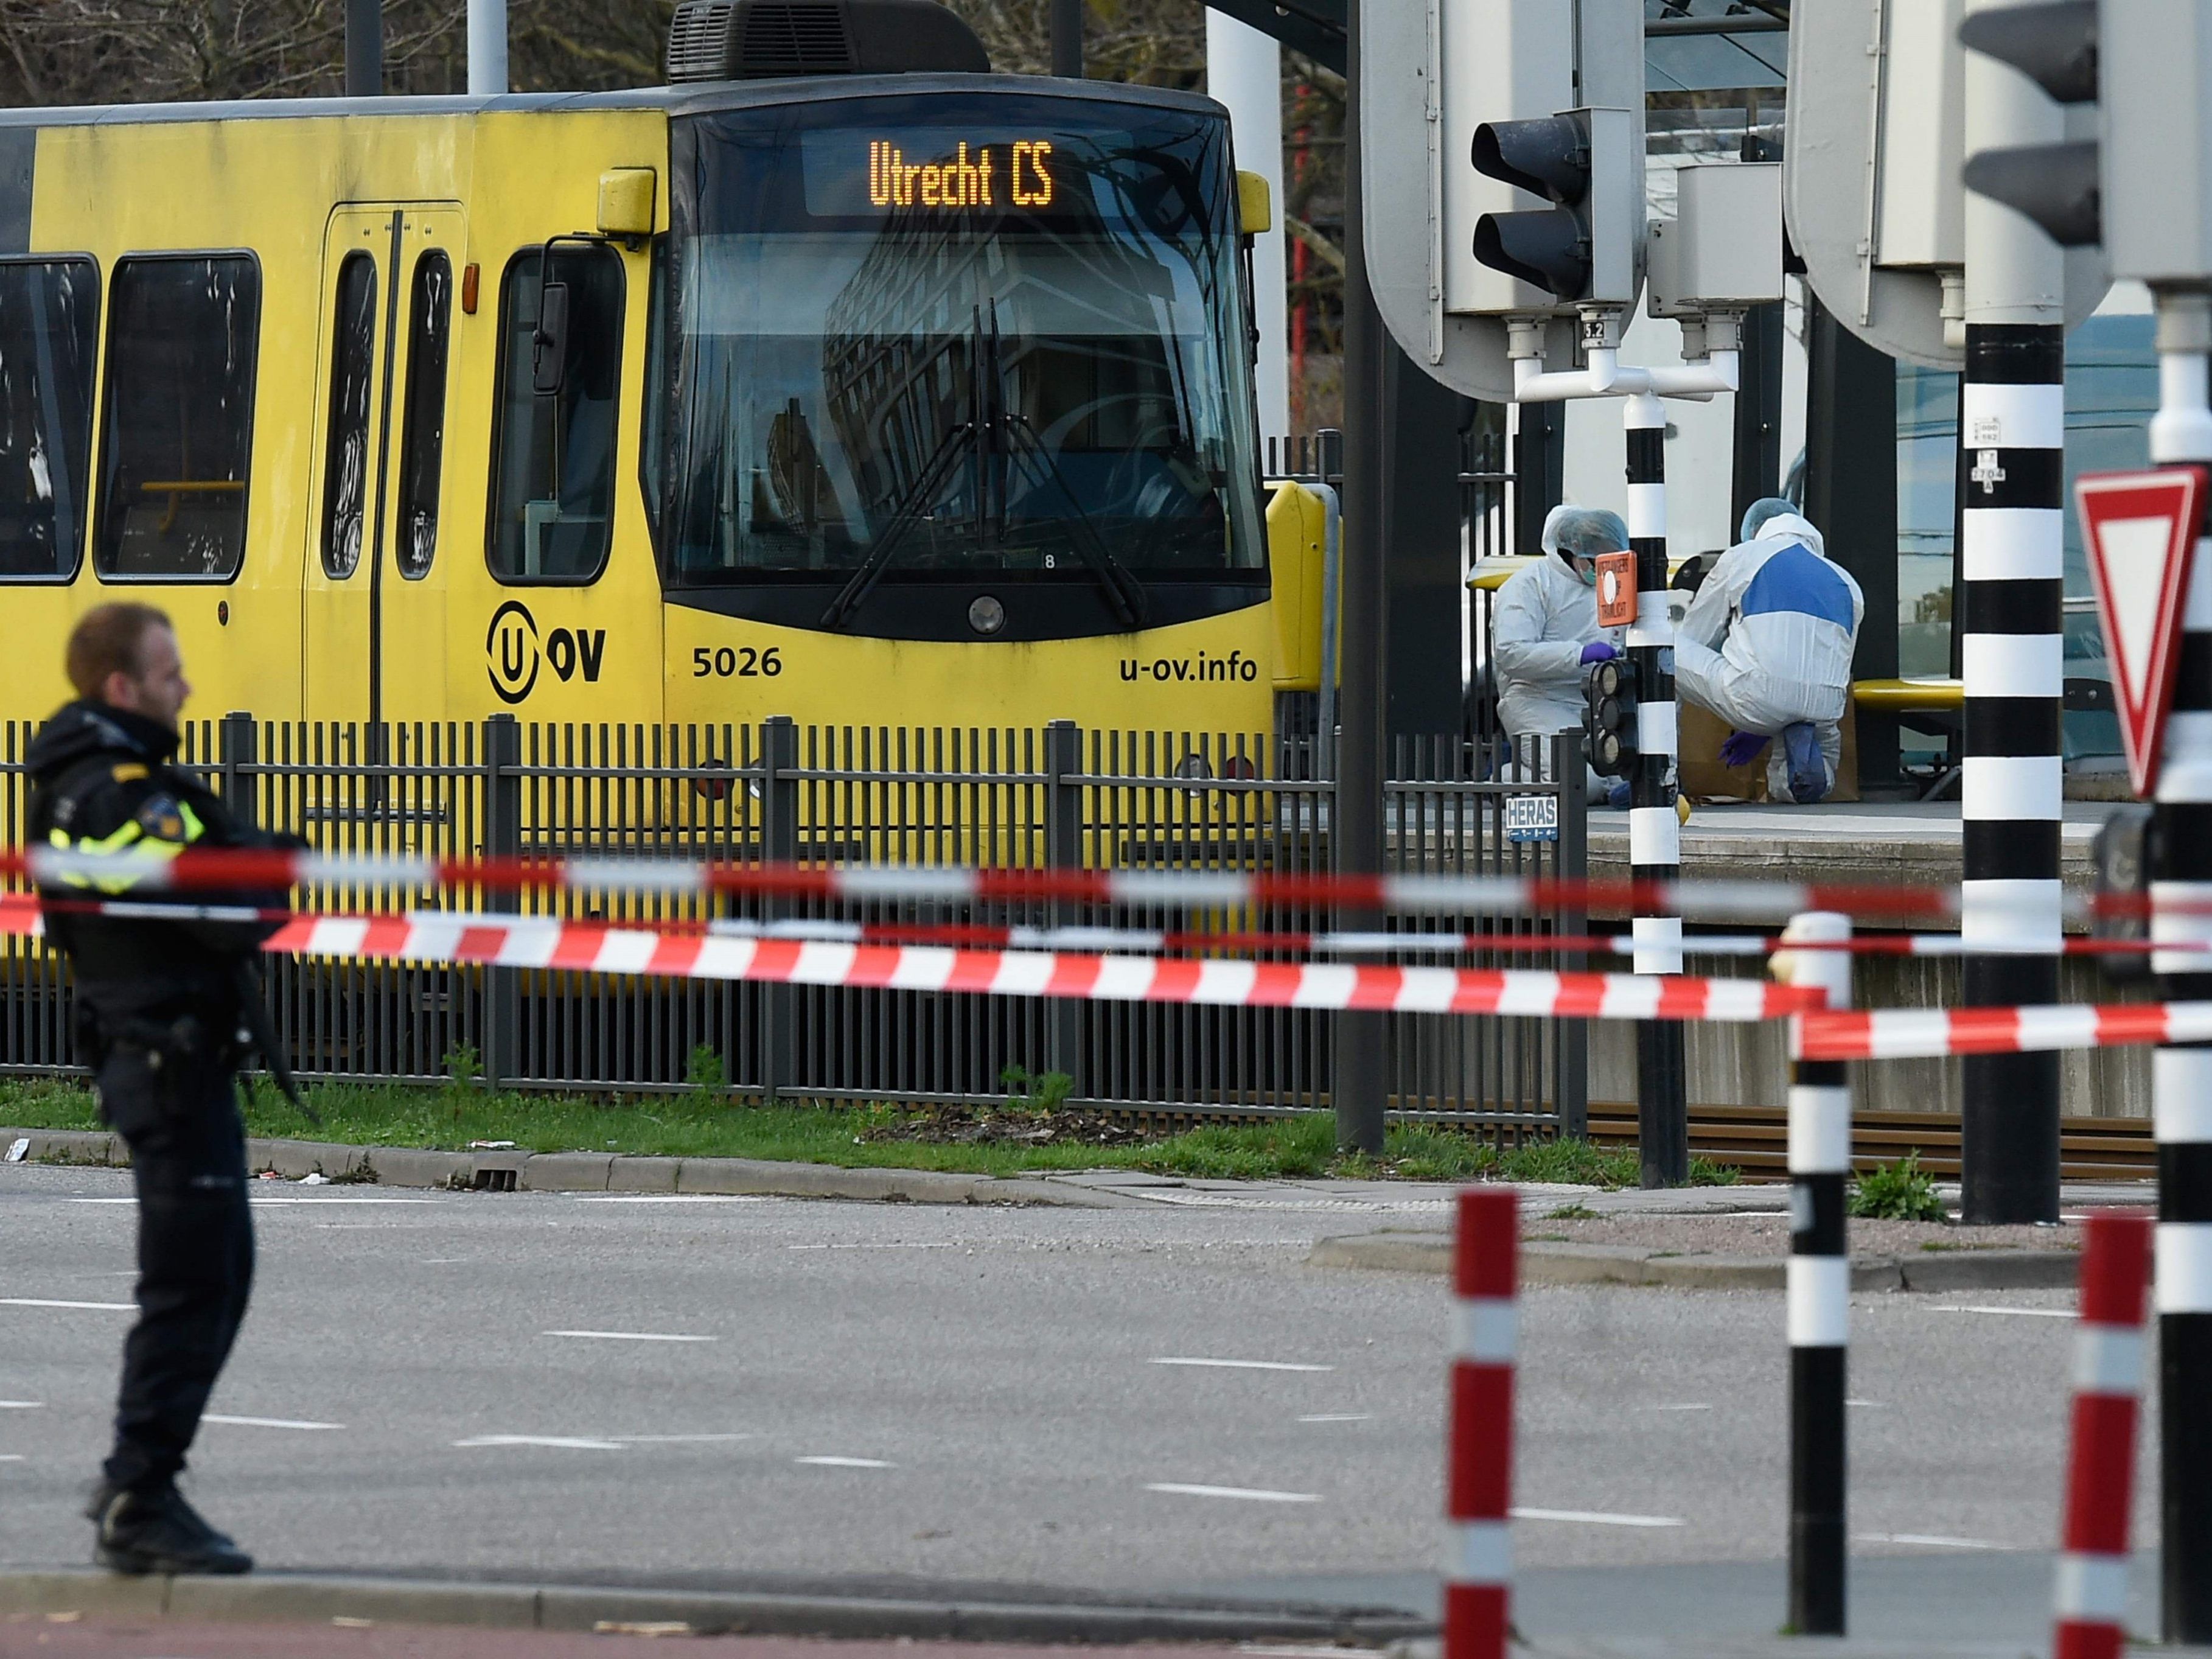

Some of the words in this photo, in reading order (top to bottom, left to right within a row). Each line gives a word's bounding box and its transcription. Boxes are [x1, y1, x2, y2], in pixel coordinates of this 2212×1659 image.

[870, 141, 991, 205] Utrecht
[1013, 141, 1052, 205] CS
[694, 647, 782, 677] 5026
[1120, 650, 1257, 682] u-ov.info
[1508, 799, 1555, 826] HERAS
